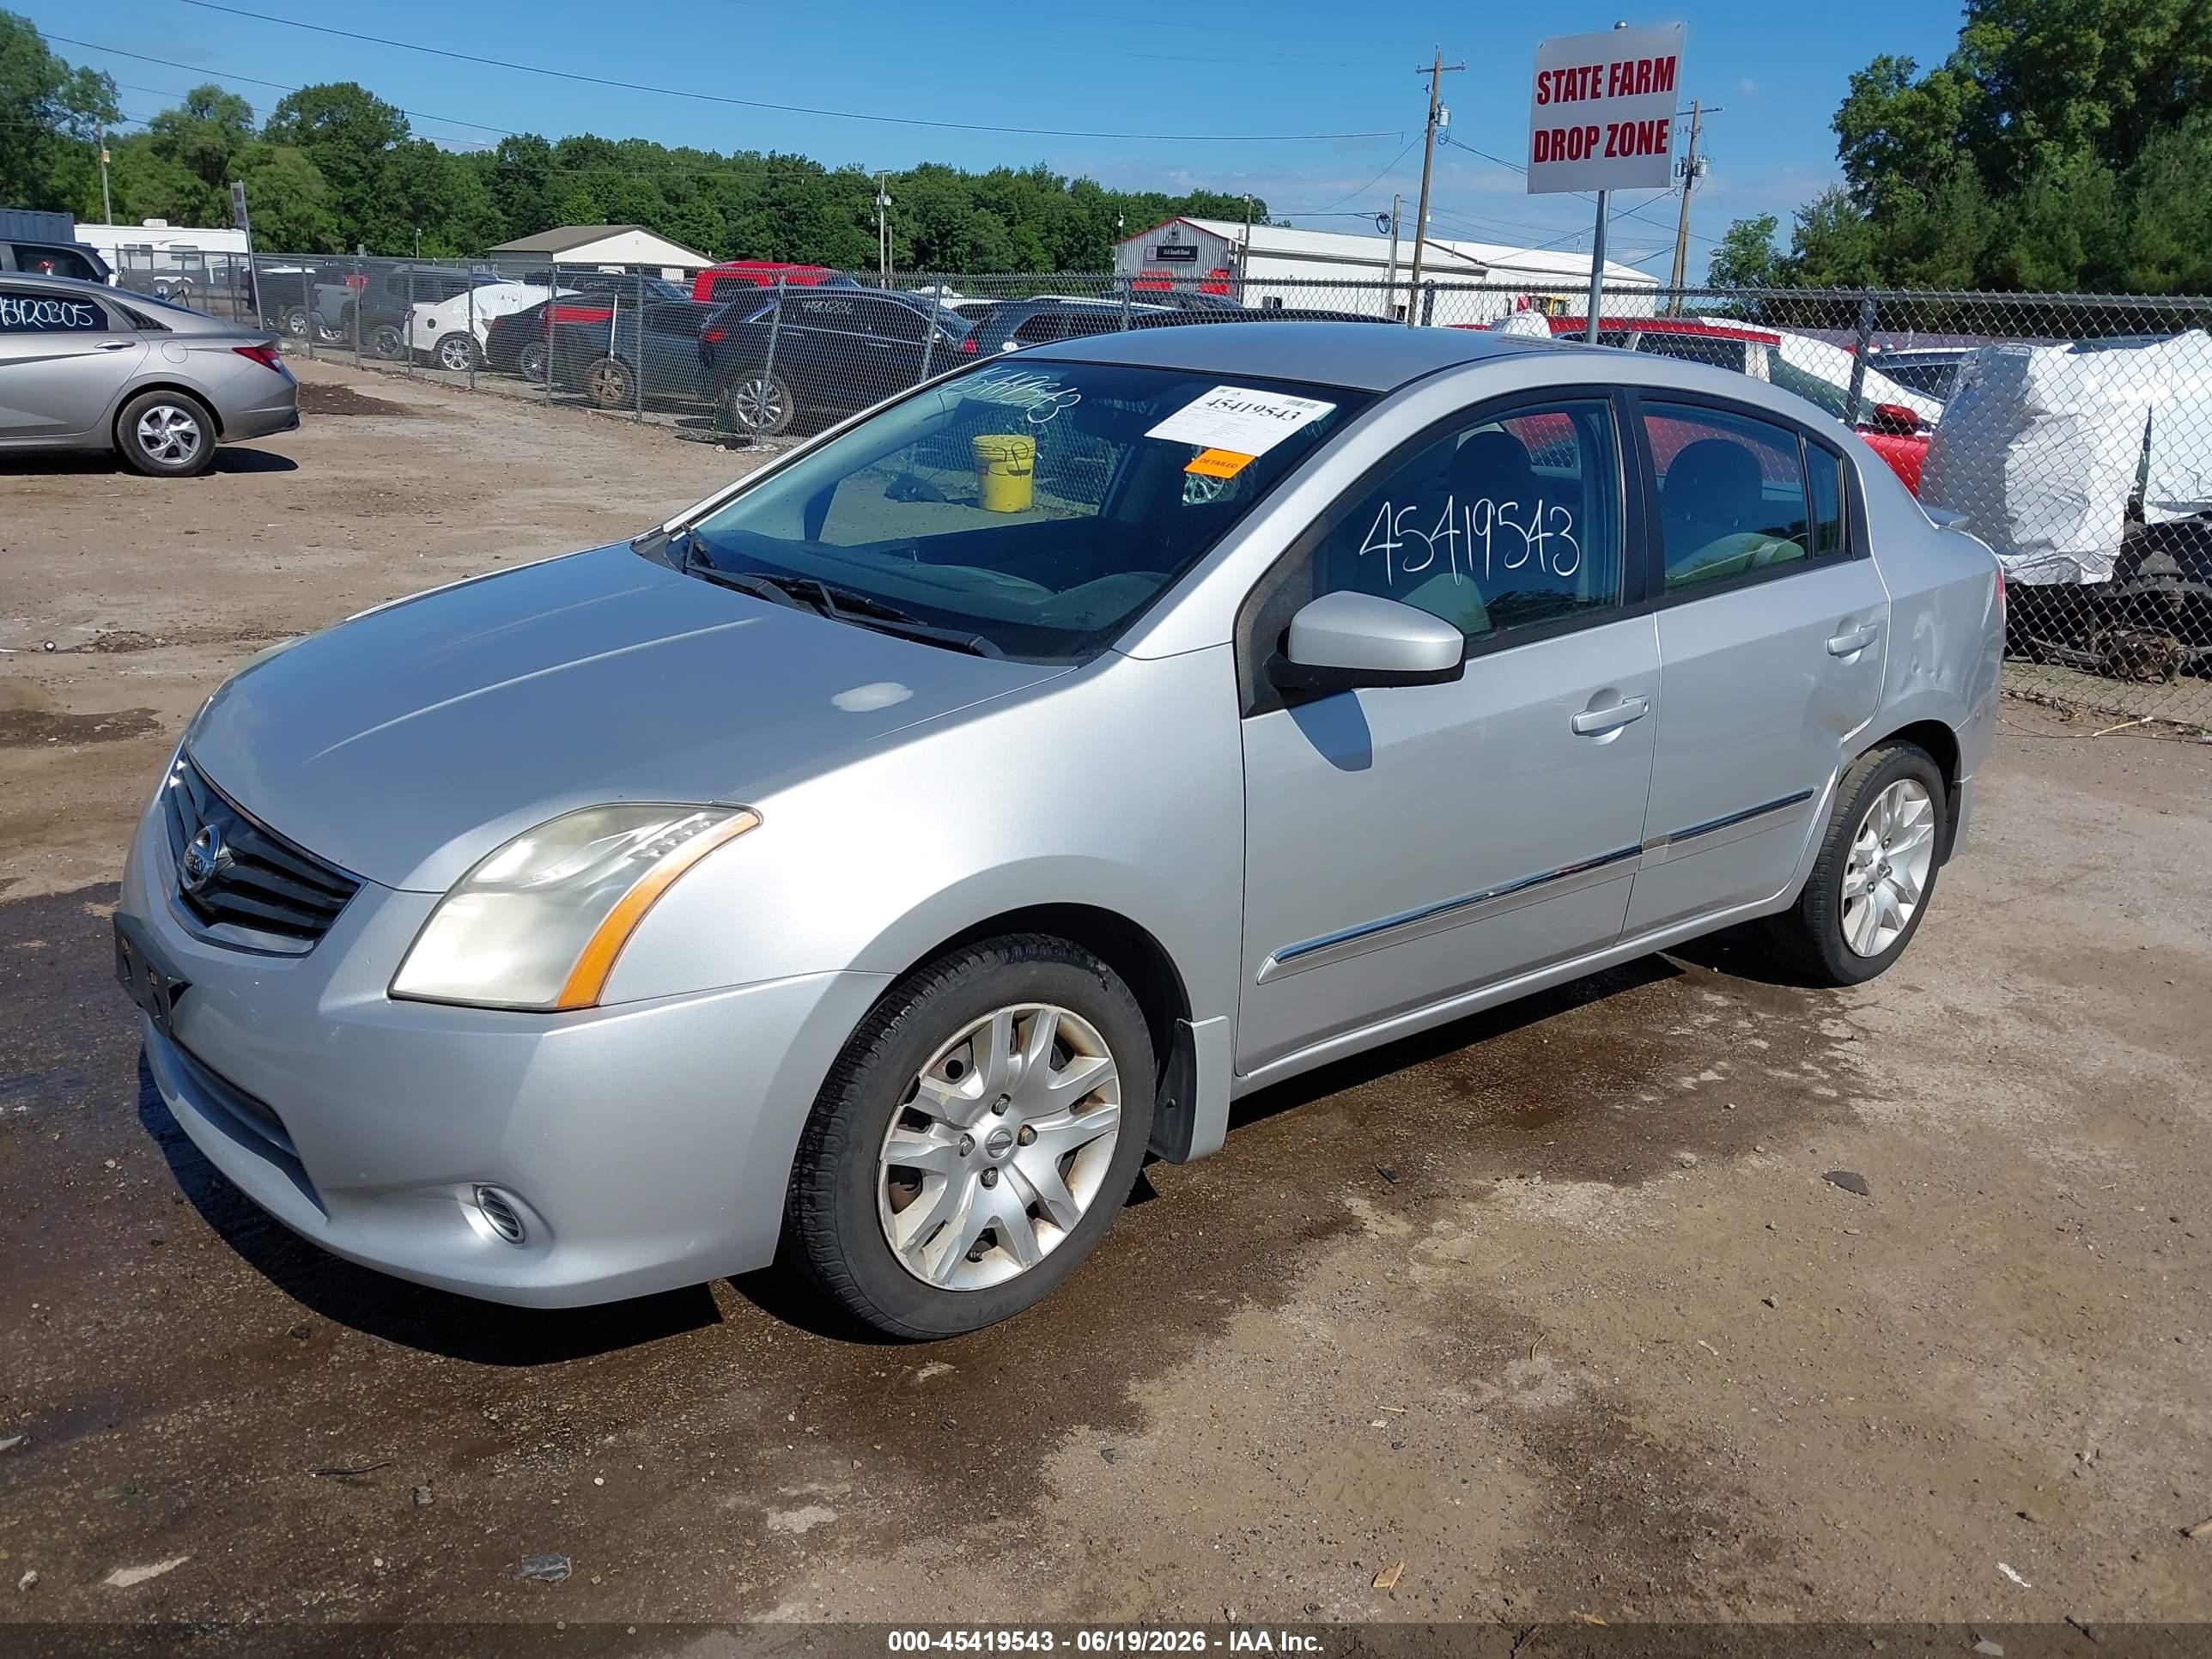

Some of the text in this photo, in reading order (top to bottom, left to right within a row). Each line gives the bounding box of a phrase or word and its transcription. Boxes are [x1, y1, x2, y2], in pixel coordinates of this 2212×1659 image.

[1536, 56, 1676, 106] STATE FARM
[1534, 118, 1670, 163] DROP ZONE
[1206, 398, 1302, 421] 45419543
[1358, 494, 1581, 586] 45419543
